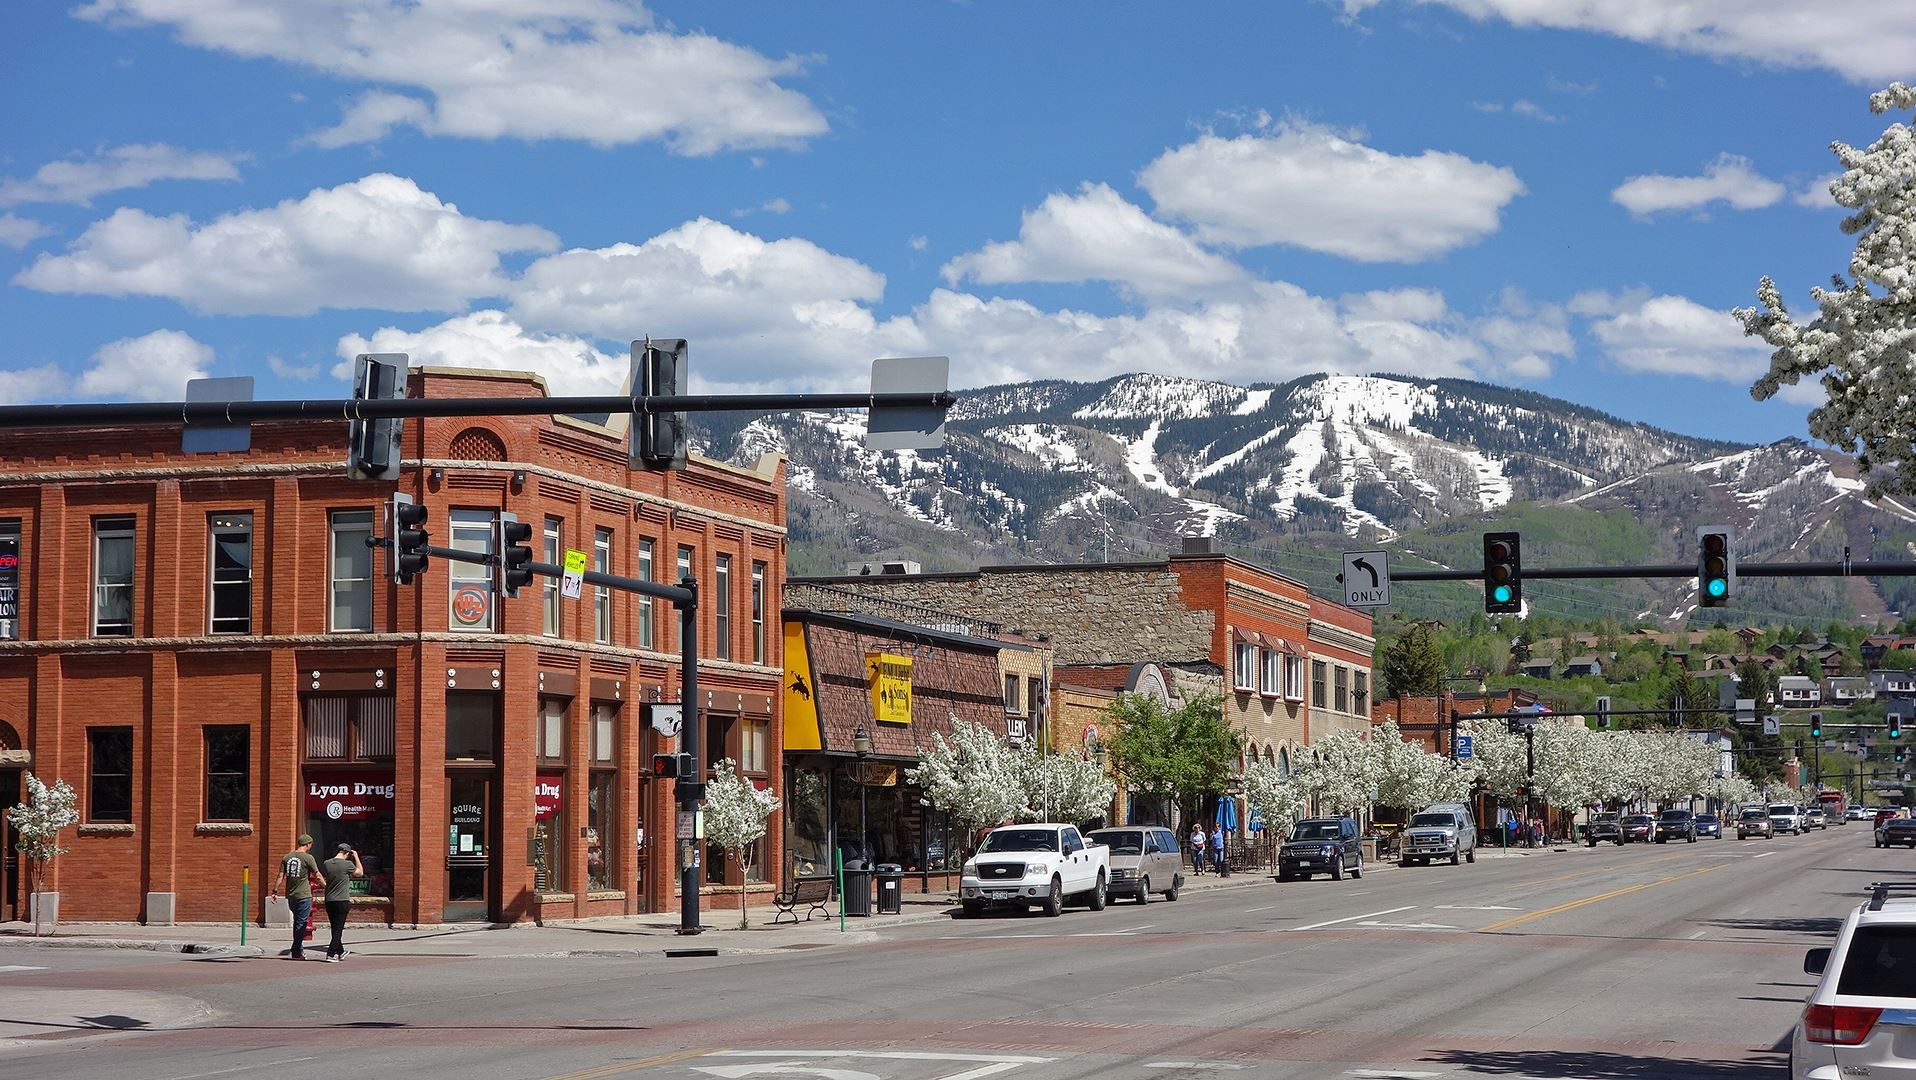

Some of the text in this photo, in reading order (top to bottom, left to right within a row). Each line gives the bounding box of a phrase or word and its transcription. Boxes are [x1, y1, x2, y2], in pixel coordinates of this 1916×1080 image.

[0, 557, 17, 566] PEN
[1351, 590, 1384, 602] ONLY
[310, 782, 395, 799] Lyon Drug
[541, 783, 560, 800] Drug
[452, 804, 482, 815] SQUIRE
[349, 880, 368, 889] ATM
